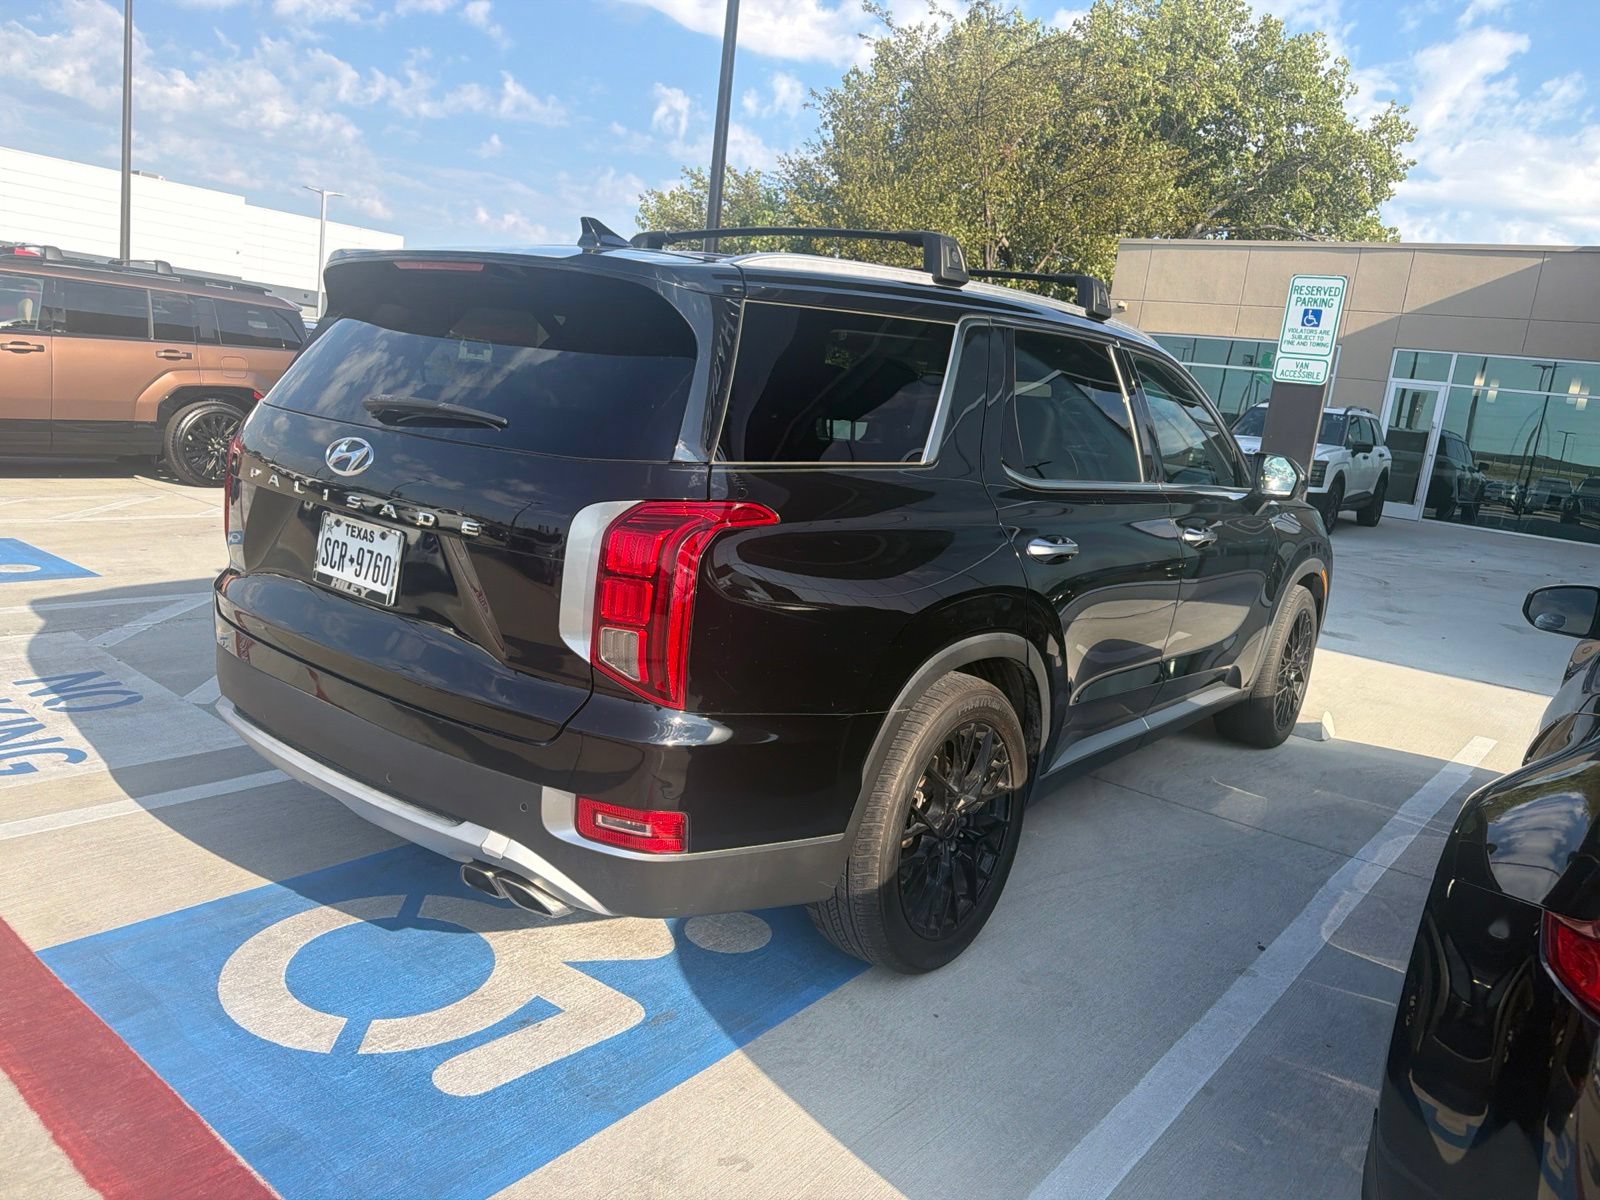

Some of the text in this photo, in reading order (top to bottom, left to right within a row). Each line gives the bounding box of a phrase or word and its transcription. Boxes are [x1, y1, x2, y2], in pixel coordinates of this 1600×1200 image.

[1293, 285, 1341, 297] RESERVED
[1295, 297, 1334, 308] PARKING
[1288, 327, 1318, 335] VIOLATORS
[1295, 361, 1309, 369] VAN
[1280, 369, 1320, 380] ACCESSIBLE
[250, 467, 482, 537] PALISADE
[345, 523, 375, 543] TEXAS
[330, 577, 372, 598] HILEY
[12, 670, 144, 713] NO
